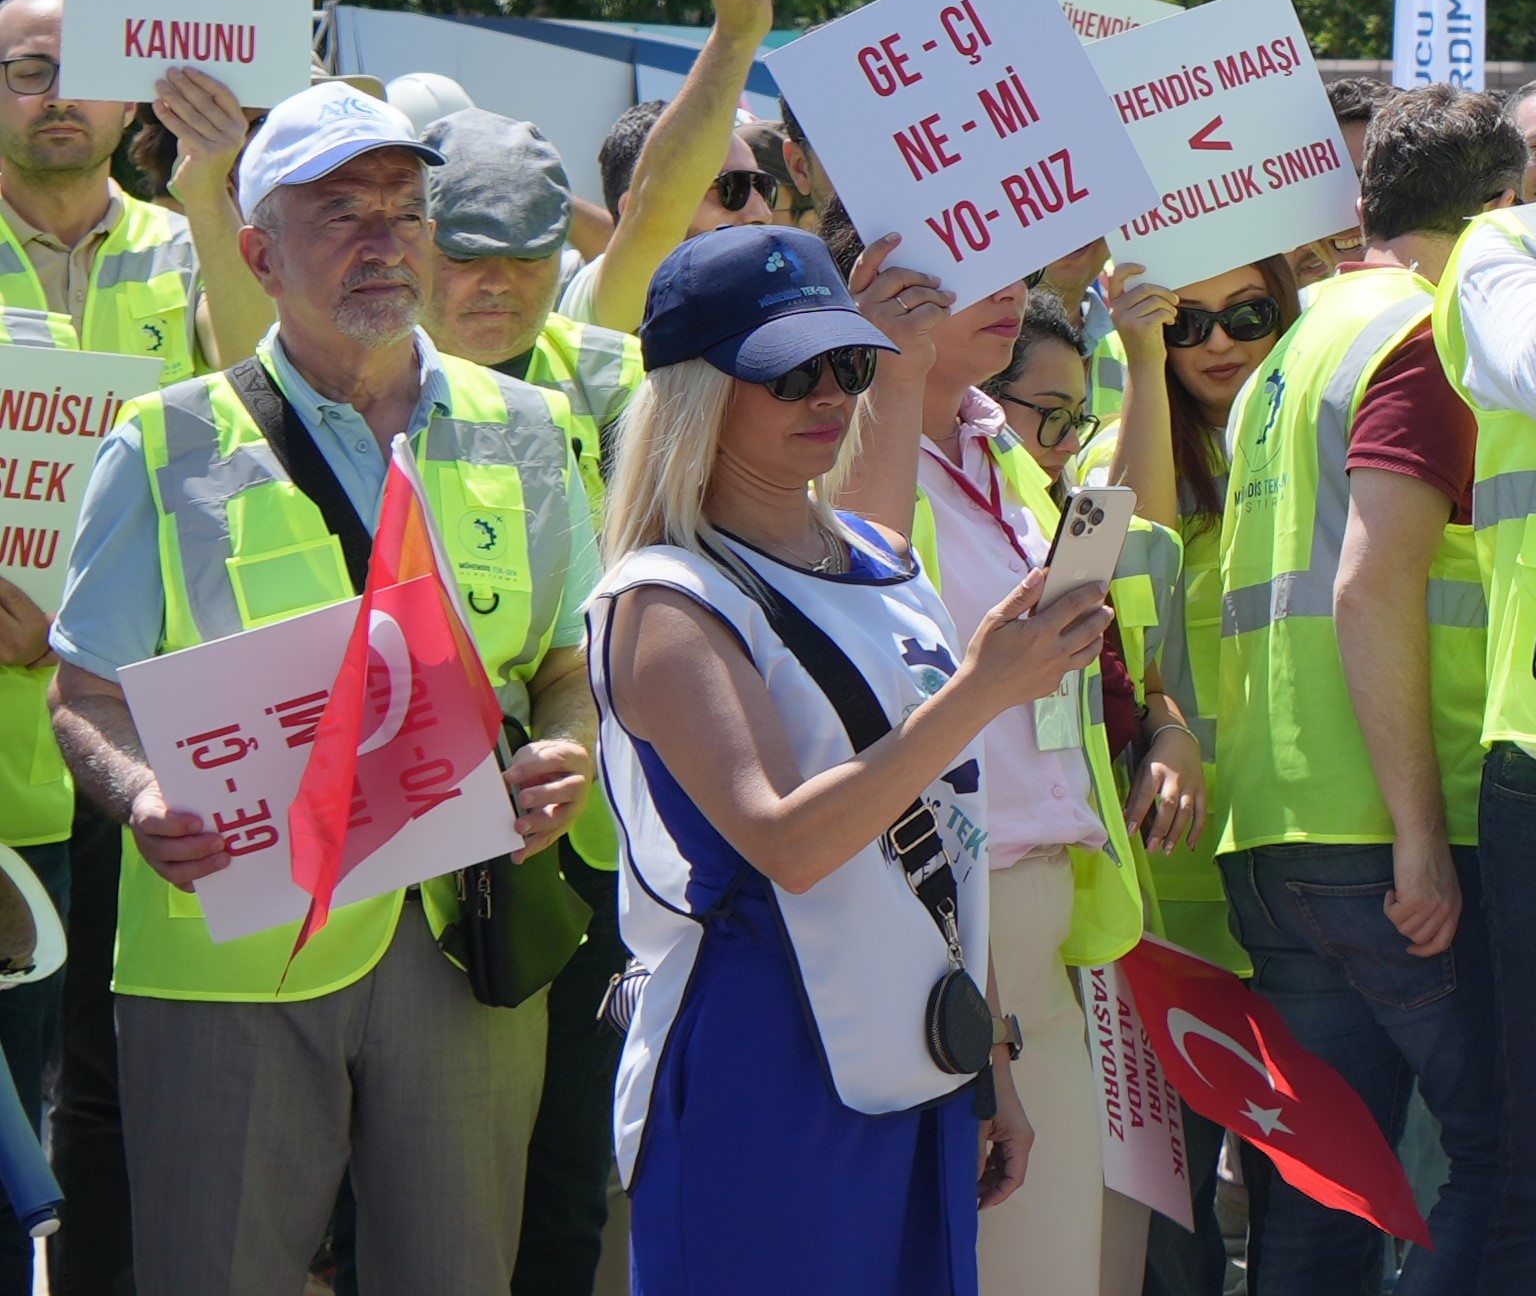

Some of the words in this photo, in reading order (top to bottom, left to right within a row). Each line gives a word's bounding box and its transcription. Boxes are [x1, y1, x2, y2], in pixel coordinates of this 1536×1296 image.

[124, 18, 256, 64] KANUNU
[1112, 64, 1214, 124] HENDİS
[1213, 36, 1302, 90] MAAŞI
[1001, 148, 1090, 229] RUZ
[1262, 138, 1341, 192] SINIRI
[0, 386, 123, 438] NDİSLİ
[1090, 968, 1125, 1143] YAŞIYORUZ
[1116, 995, 1145, 1128] ALTINDA
[1140, 1027, 1163, 1125] SINIRI
